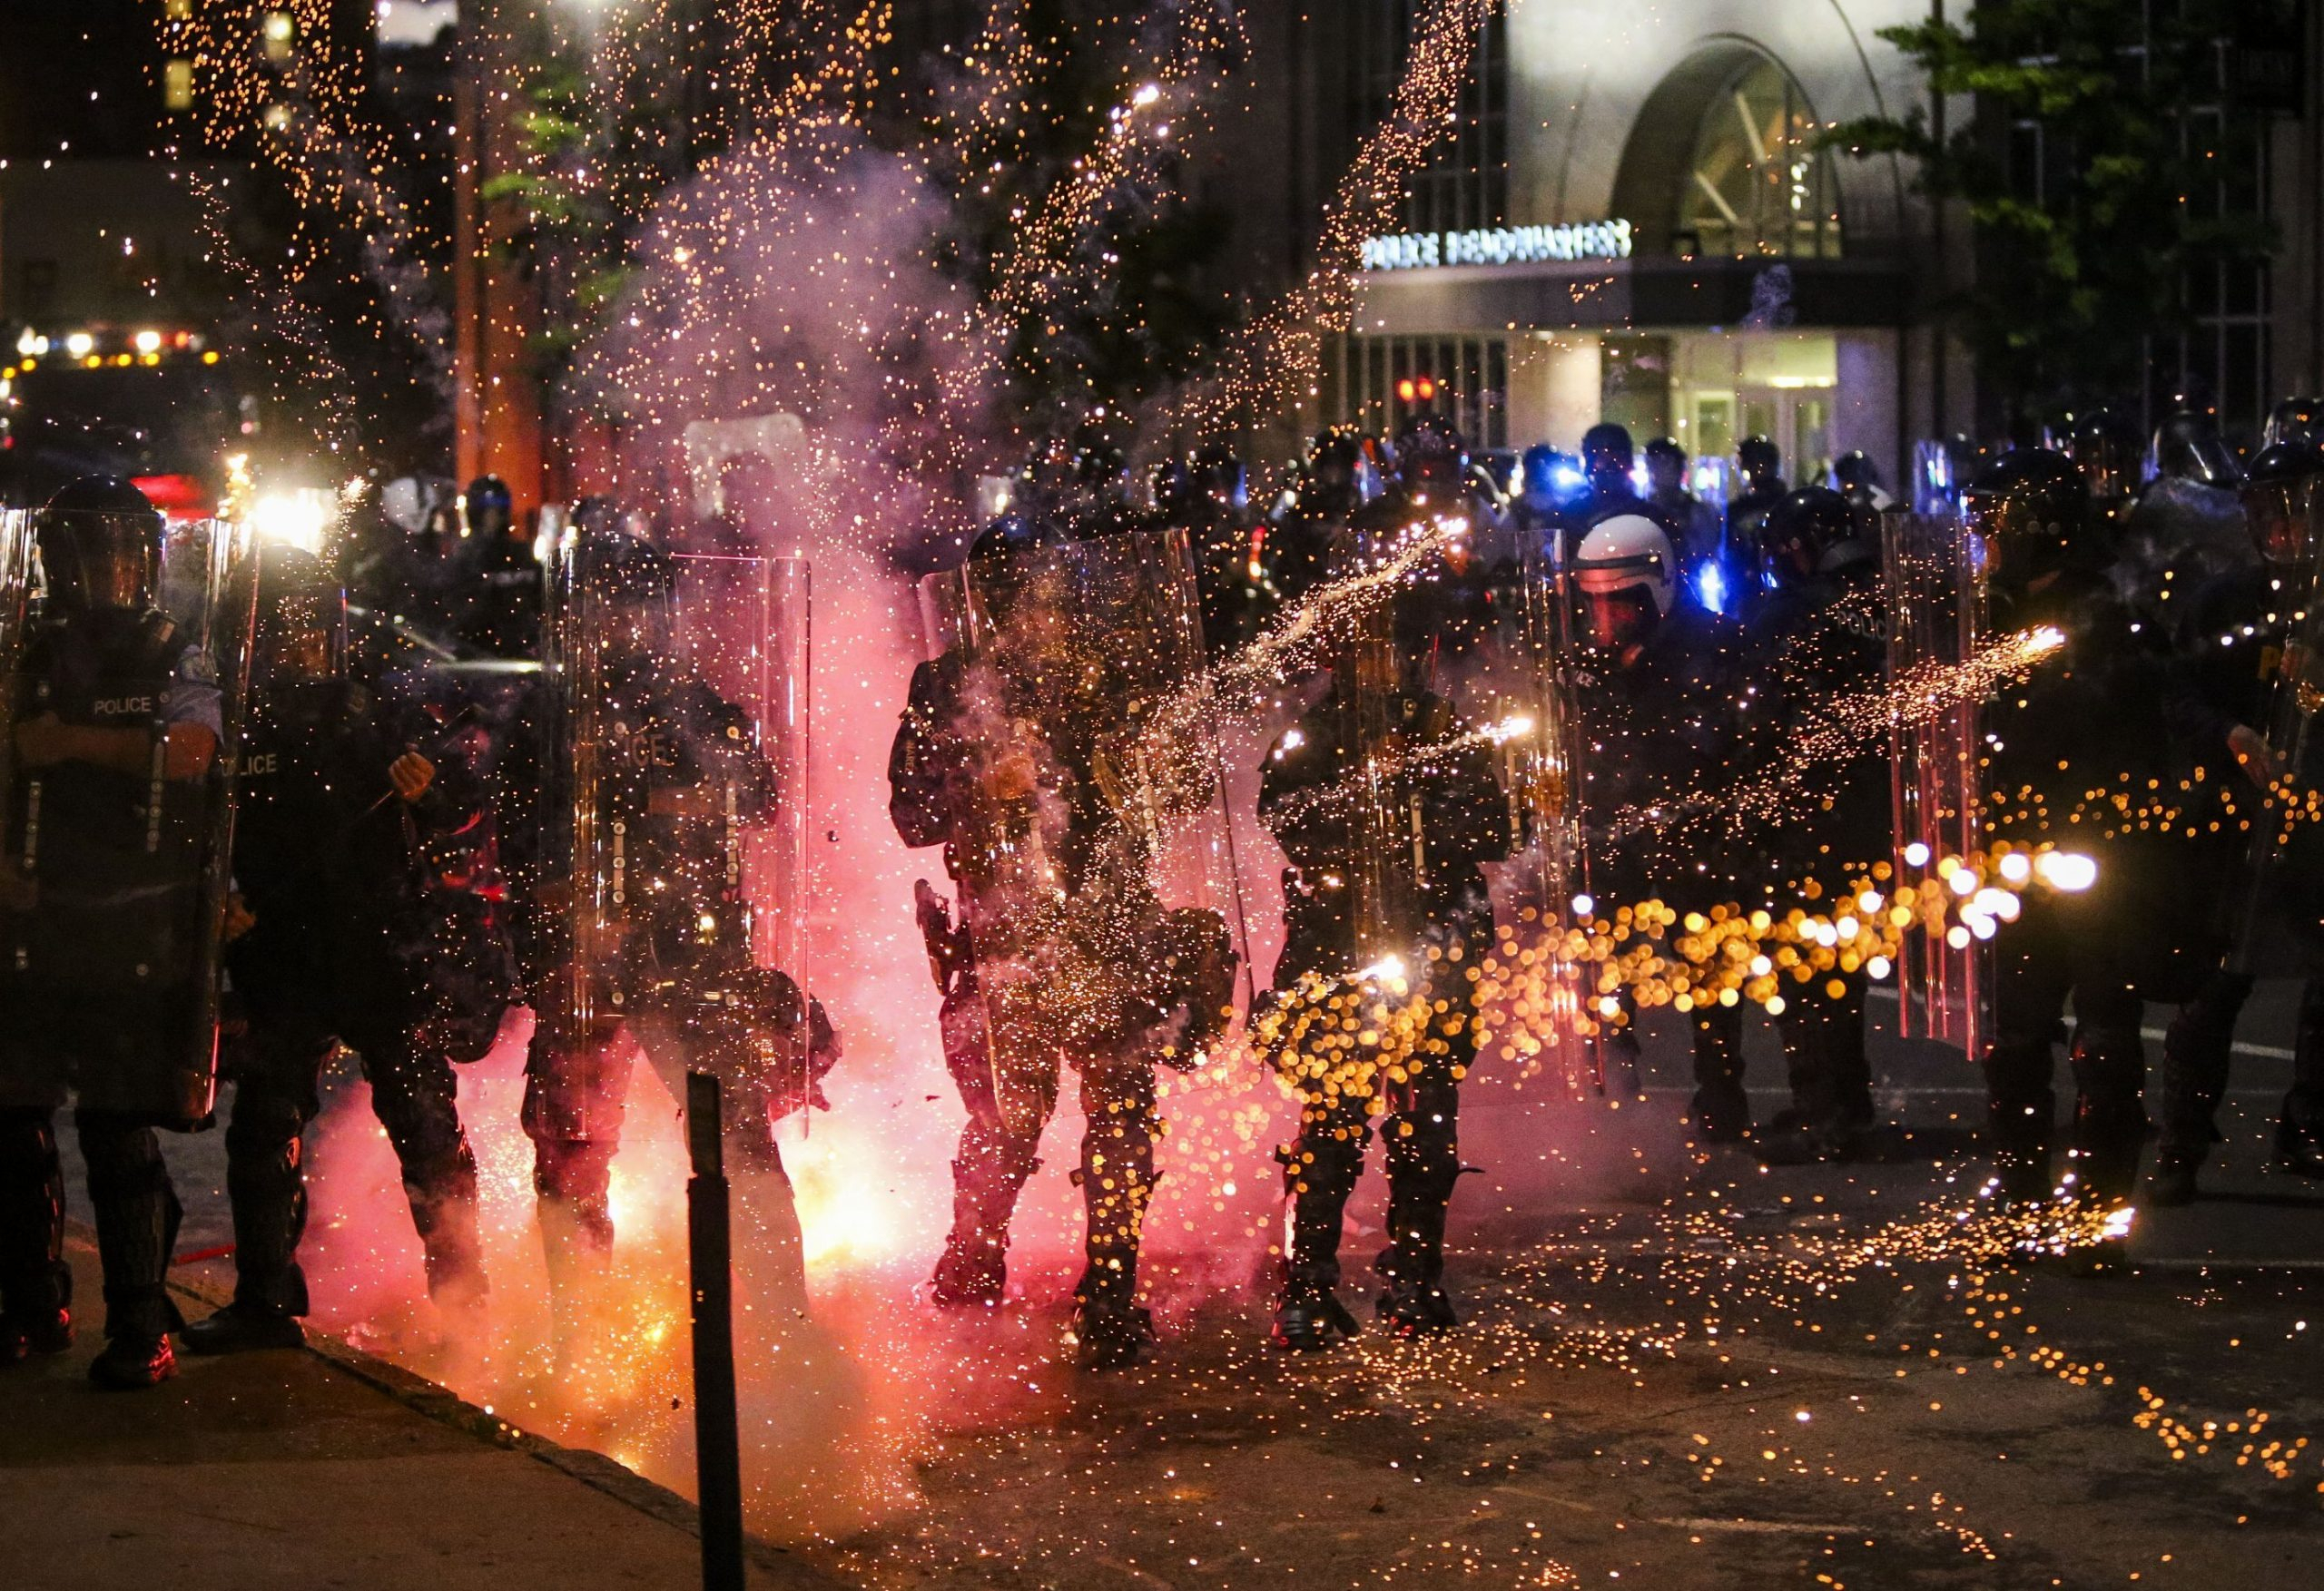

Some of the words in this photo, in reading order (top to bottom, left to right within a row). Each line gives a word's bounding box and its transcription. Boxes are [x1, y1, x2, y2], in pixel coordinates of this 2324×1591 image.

[1837, 610, 1886, 642] POLIC
[94, 697, 152, 715] POLICE
[595, 733, 667, 769] PICE
